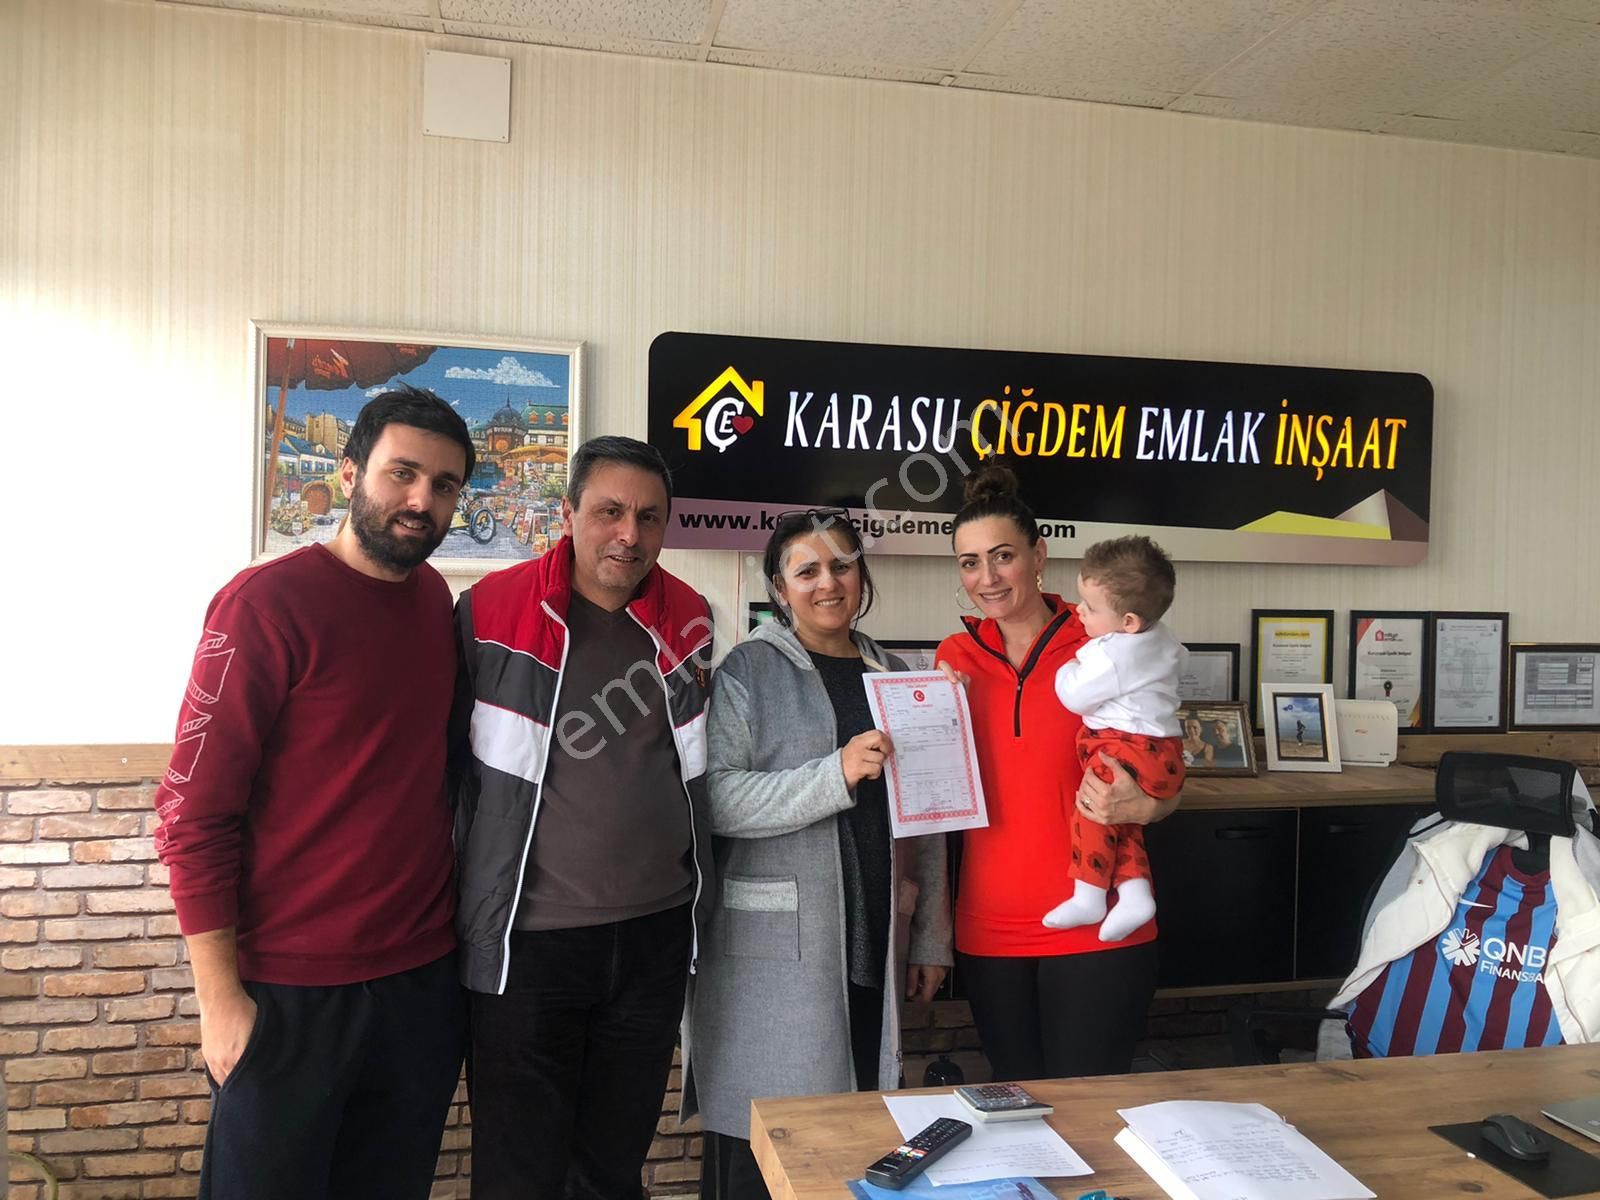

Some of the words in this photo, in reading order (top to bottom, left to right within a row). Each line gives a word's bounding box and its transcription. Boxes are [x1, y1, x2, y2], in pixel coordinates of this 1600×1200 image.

[784, 391, 961, 454] KARASU
[971, 385, 1126, 461] ÇİĞDEM
[1136, 406, 1265, 464] EMLAK
[1274, 399, 1407, 481] İNŞAAT
[1483, 937, 1547, 968] QNB
